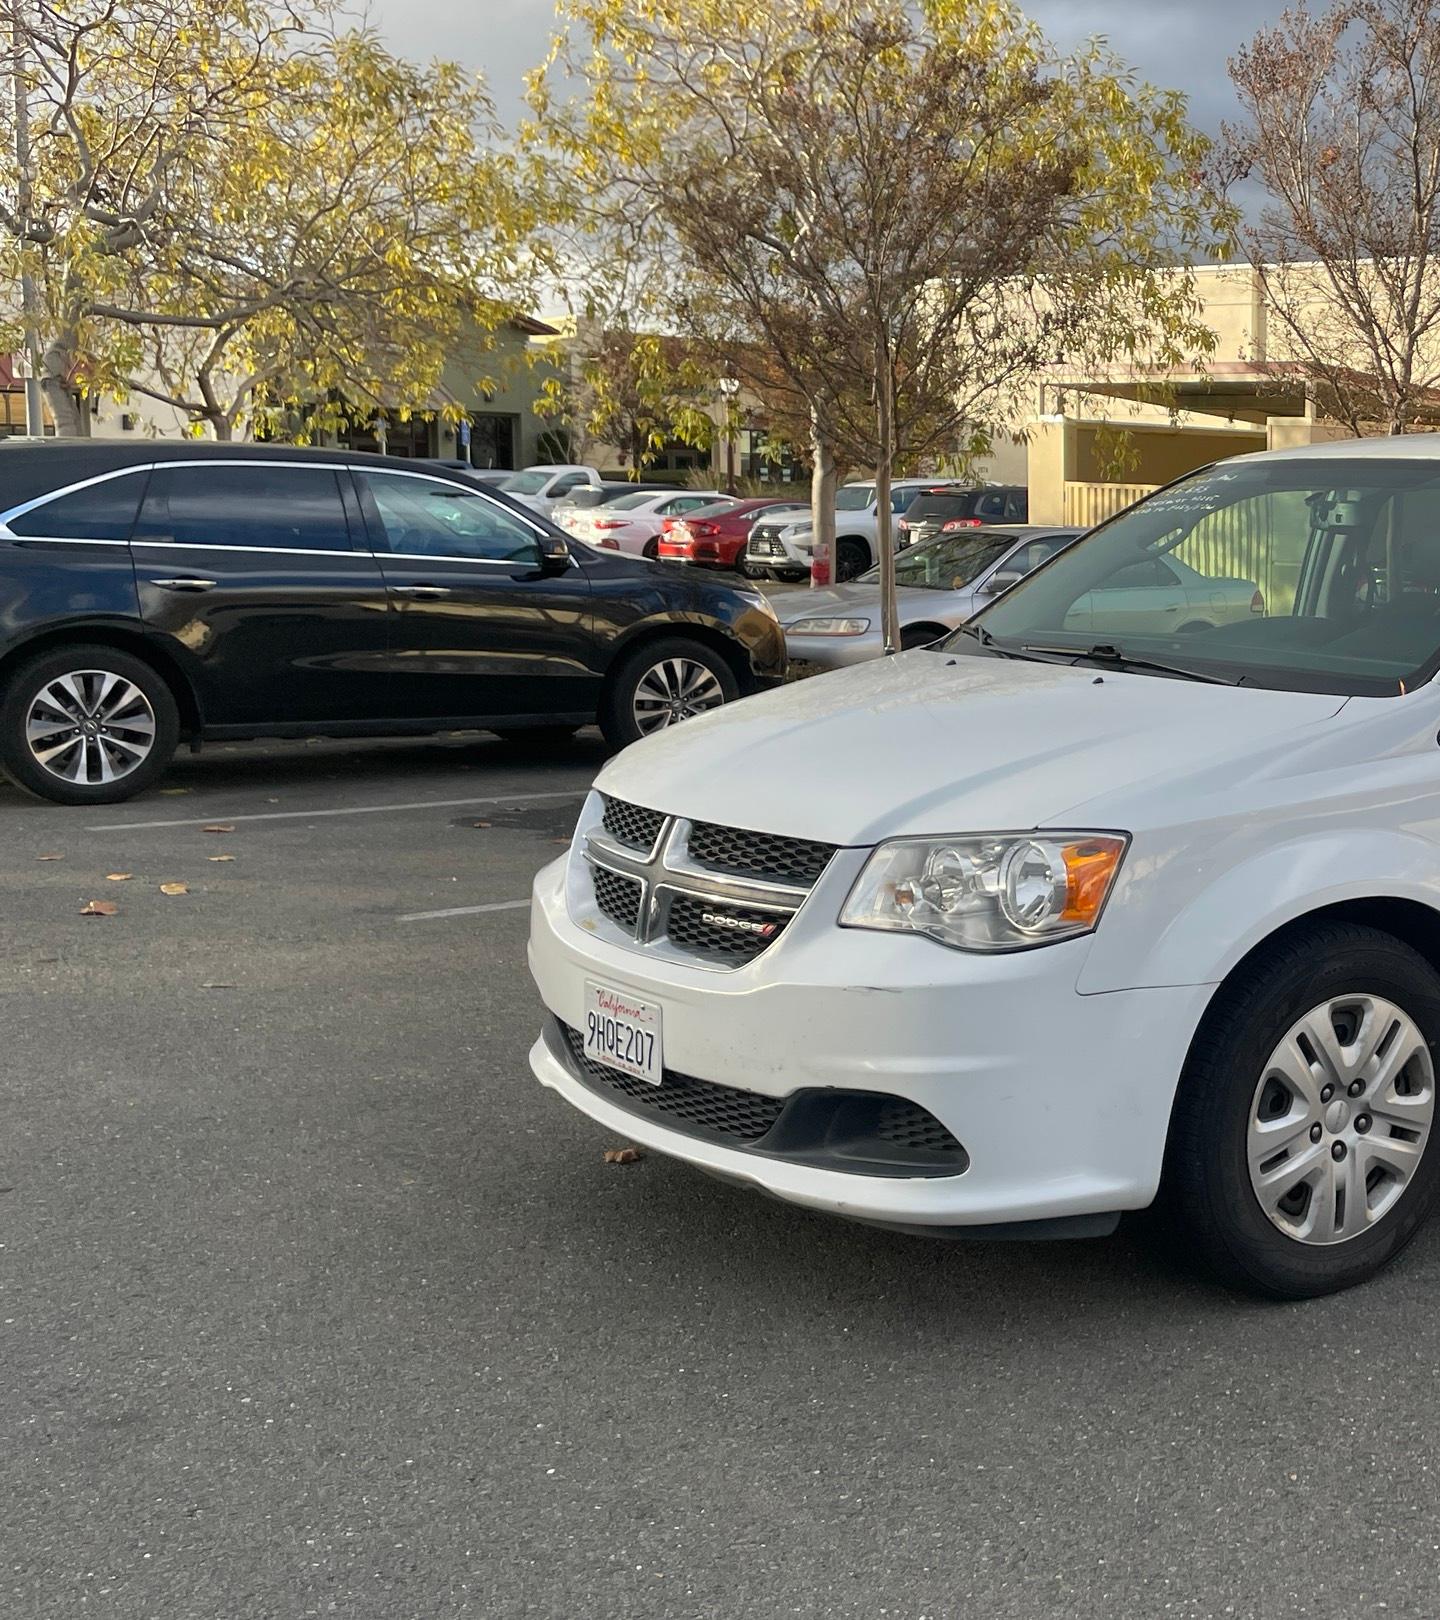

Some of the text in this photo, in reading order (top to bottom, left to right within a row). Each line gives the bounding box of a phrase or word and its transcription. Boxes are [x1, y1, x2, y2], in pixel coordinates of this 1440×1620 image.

[702, 913, 764, 933] DODGE
[597, 990, 646, 1022] California
[588, 1011, 655, 1071] 9HQE207
